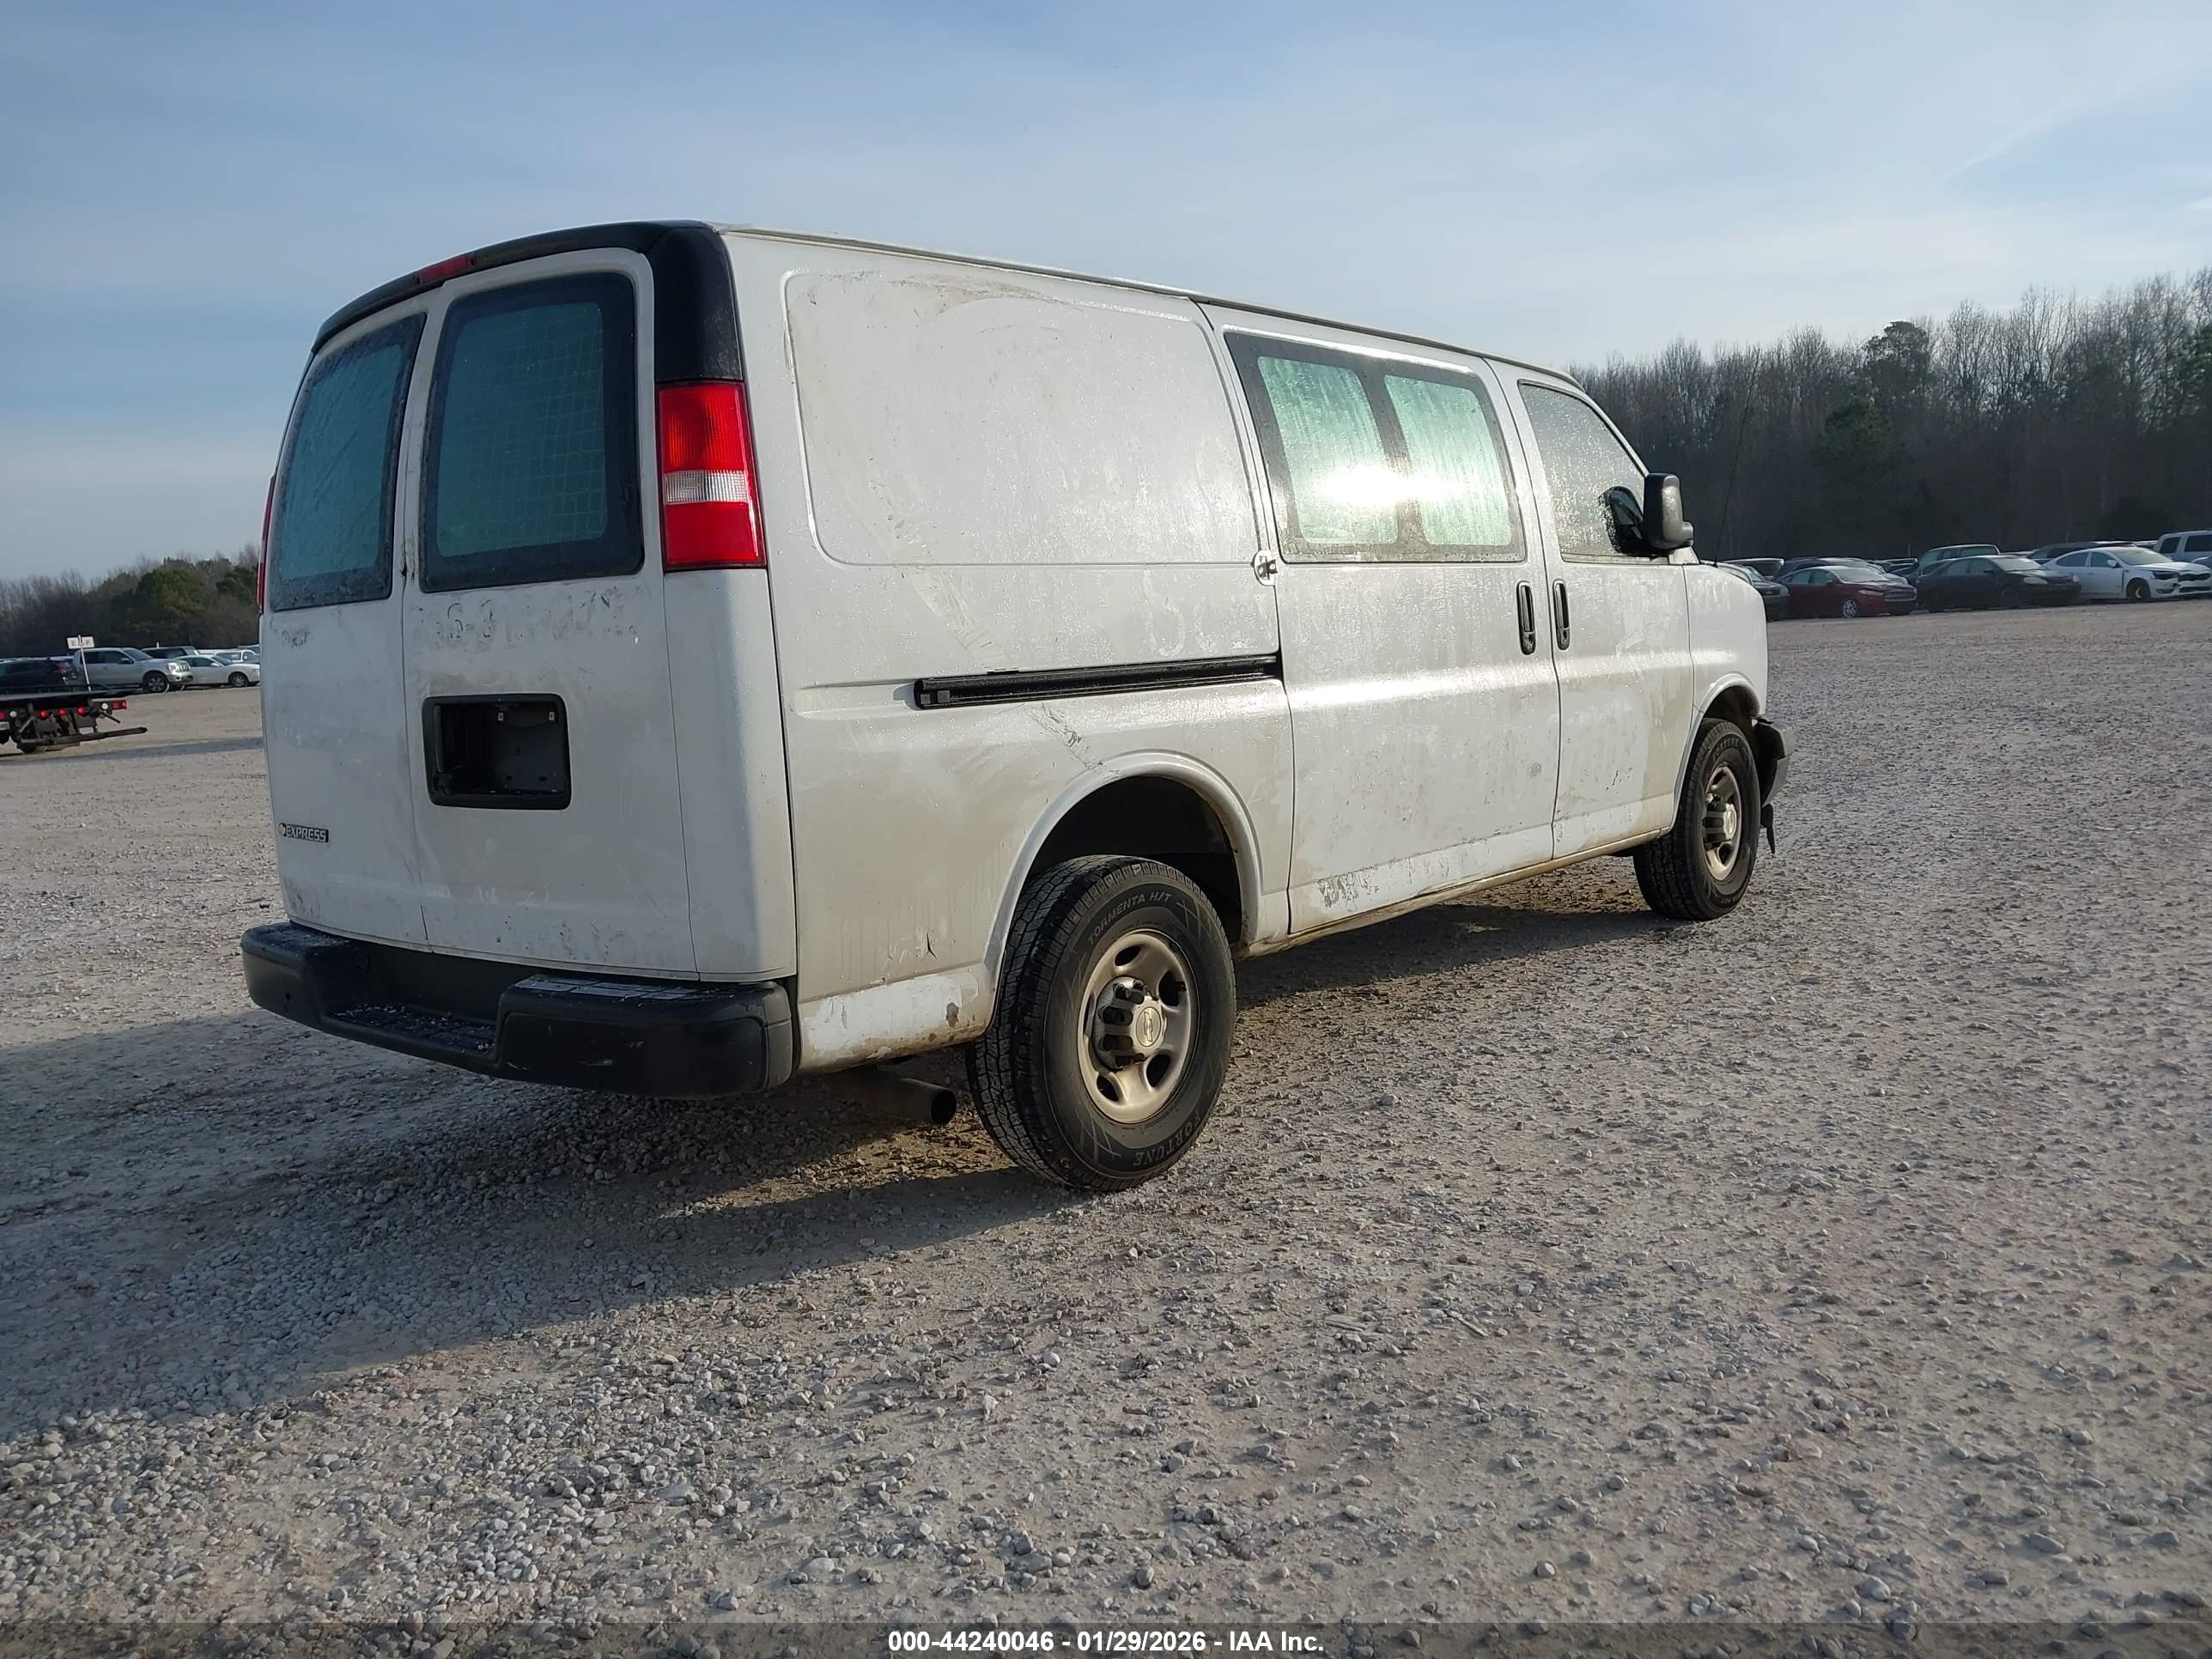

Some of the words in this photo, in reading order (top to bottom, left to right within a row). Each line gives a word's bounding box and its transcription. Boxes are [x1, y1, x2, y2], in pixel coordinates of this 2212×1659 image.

[286, 825, 326, 842] EXPRESS
[1088, 894, 1146, 945] TORMENTA
[1149, 891, 1174, 903] H/T
[1132, 1110, 1200, 1167] FORTUNE
